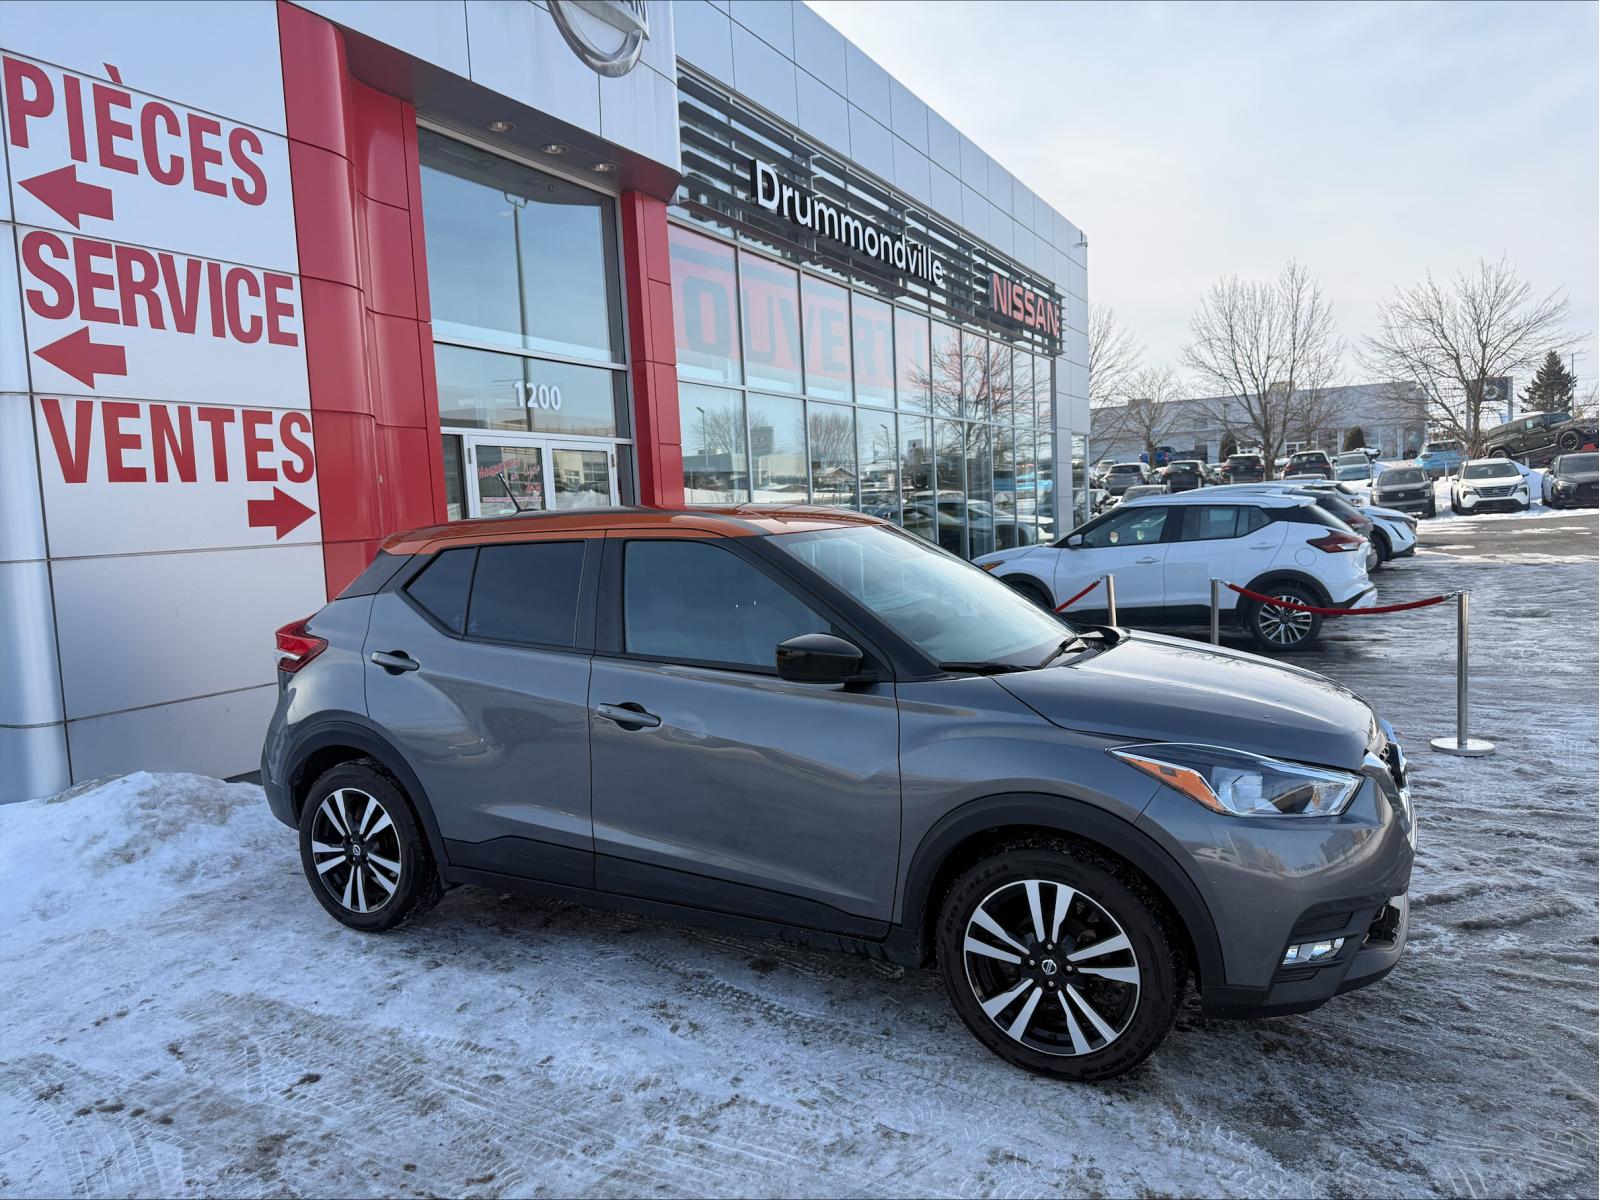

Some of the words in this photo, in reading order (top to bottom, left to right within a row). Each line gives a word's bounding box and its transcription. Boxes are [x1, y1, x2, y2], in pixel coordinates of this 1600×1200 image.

[3, 57, 267, 206] PIÈCES
[755, 160, 943, 286] Drummondville
[22, 231, 298, 347] SERVICE
[683, 275, 895, 381] OUVERT
[993, 272, 1058, 337] NISSAN
[40, 398, 315, 485] VENTES
[515, 381, 561, 411] 1200
